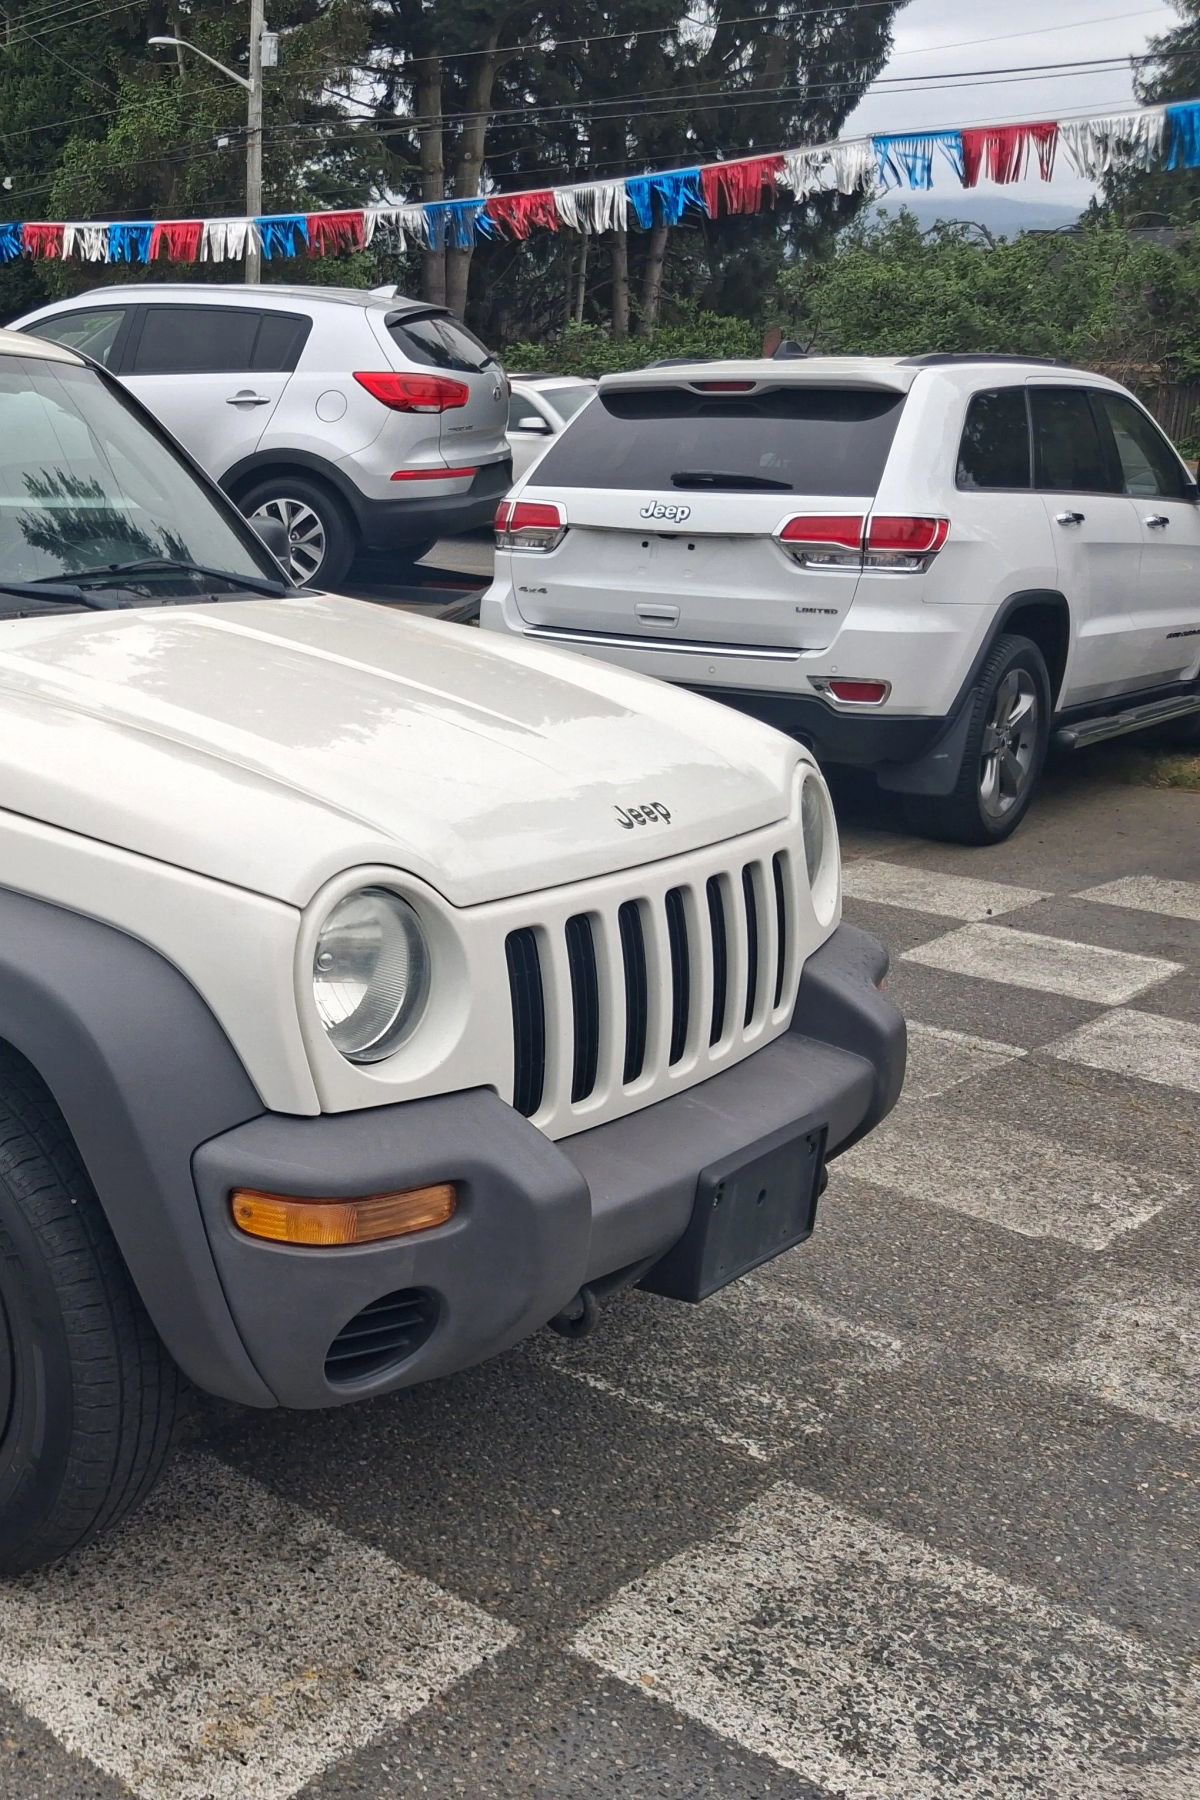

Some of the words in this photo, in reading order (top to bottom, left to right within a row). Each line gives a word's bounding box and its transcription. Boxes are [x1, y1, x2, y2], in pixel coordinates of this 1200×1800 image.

[640, 501, 691, 523] Jeep
[795, 606, 838, 615] LIMITED
[612, 801, 672, 830] Jeep
